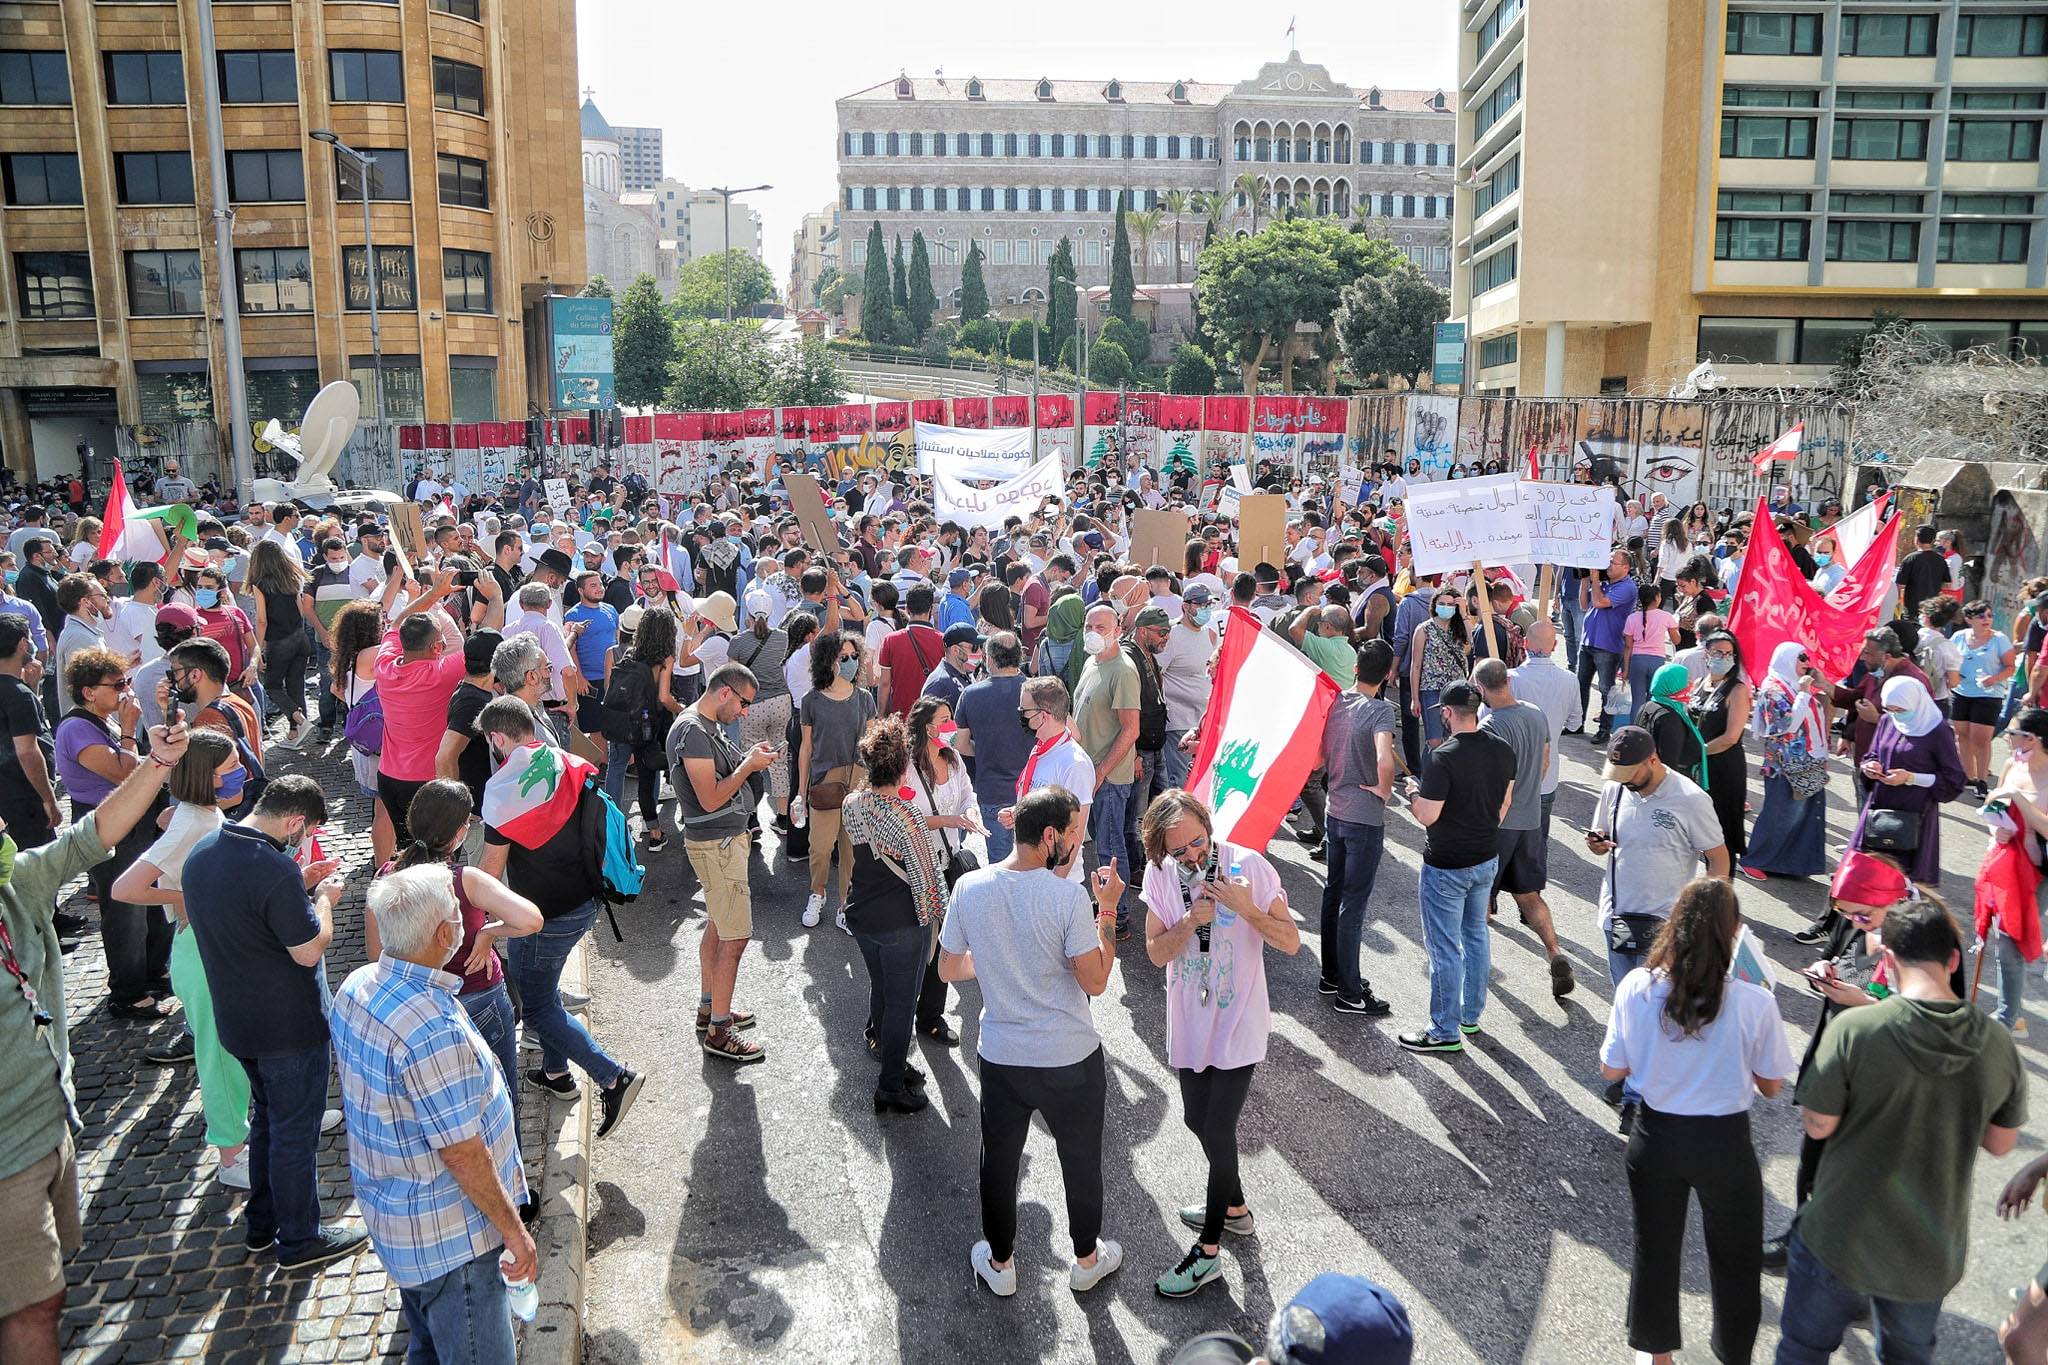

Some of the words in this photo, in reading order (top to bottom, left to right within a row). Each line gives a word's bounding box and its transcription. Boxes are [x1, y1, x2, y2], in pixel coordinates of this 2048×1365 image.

[957, 446, 1000, 462] بصلاحيات
[1002, 449, 1031, 462] حكومة
[1579, 511, 1601, 524] من
[1588, 522, 1608, 542] لا
[952, 676, 965, 692] 3
